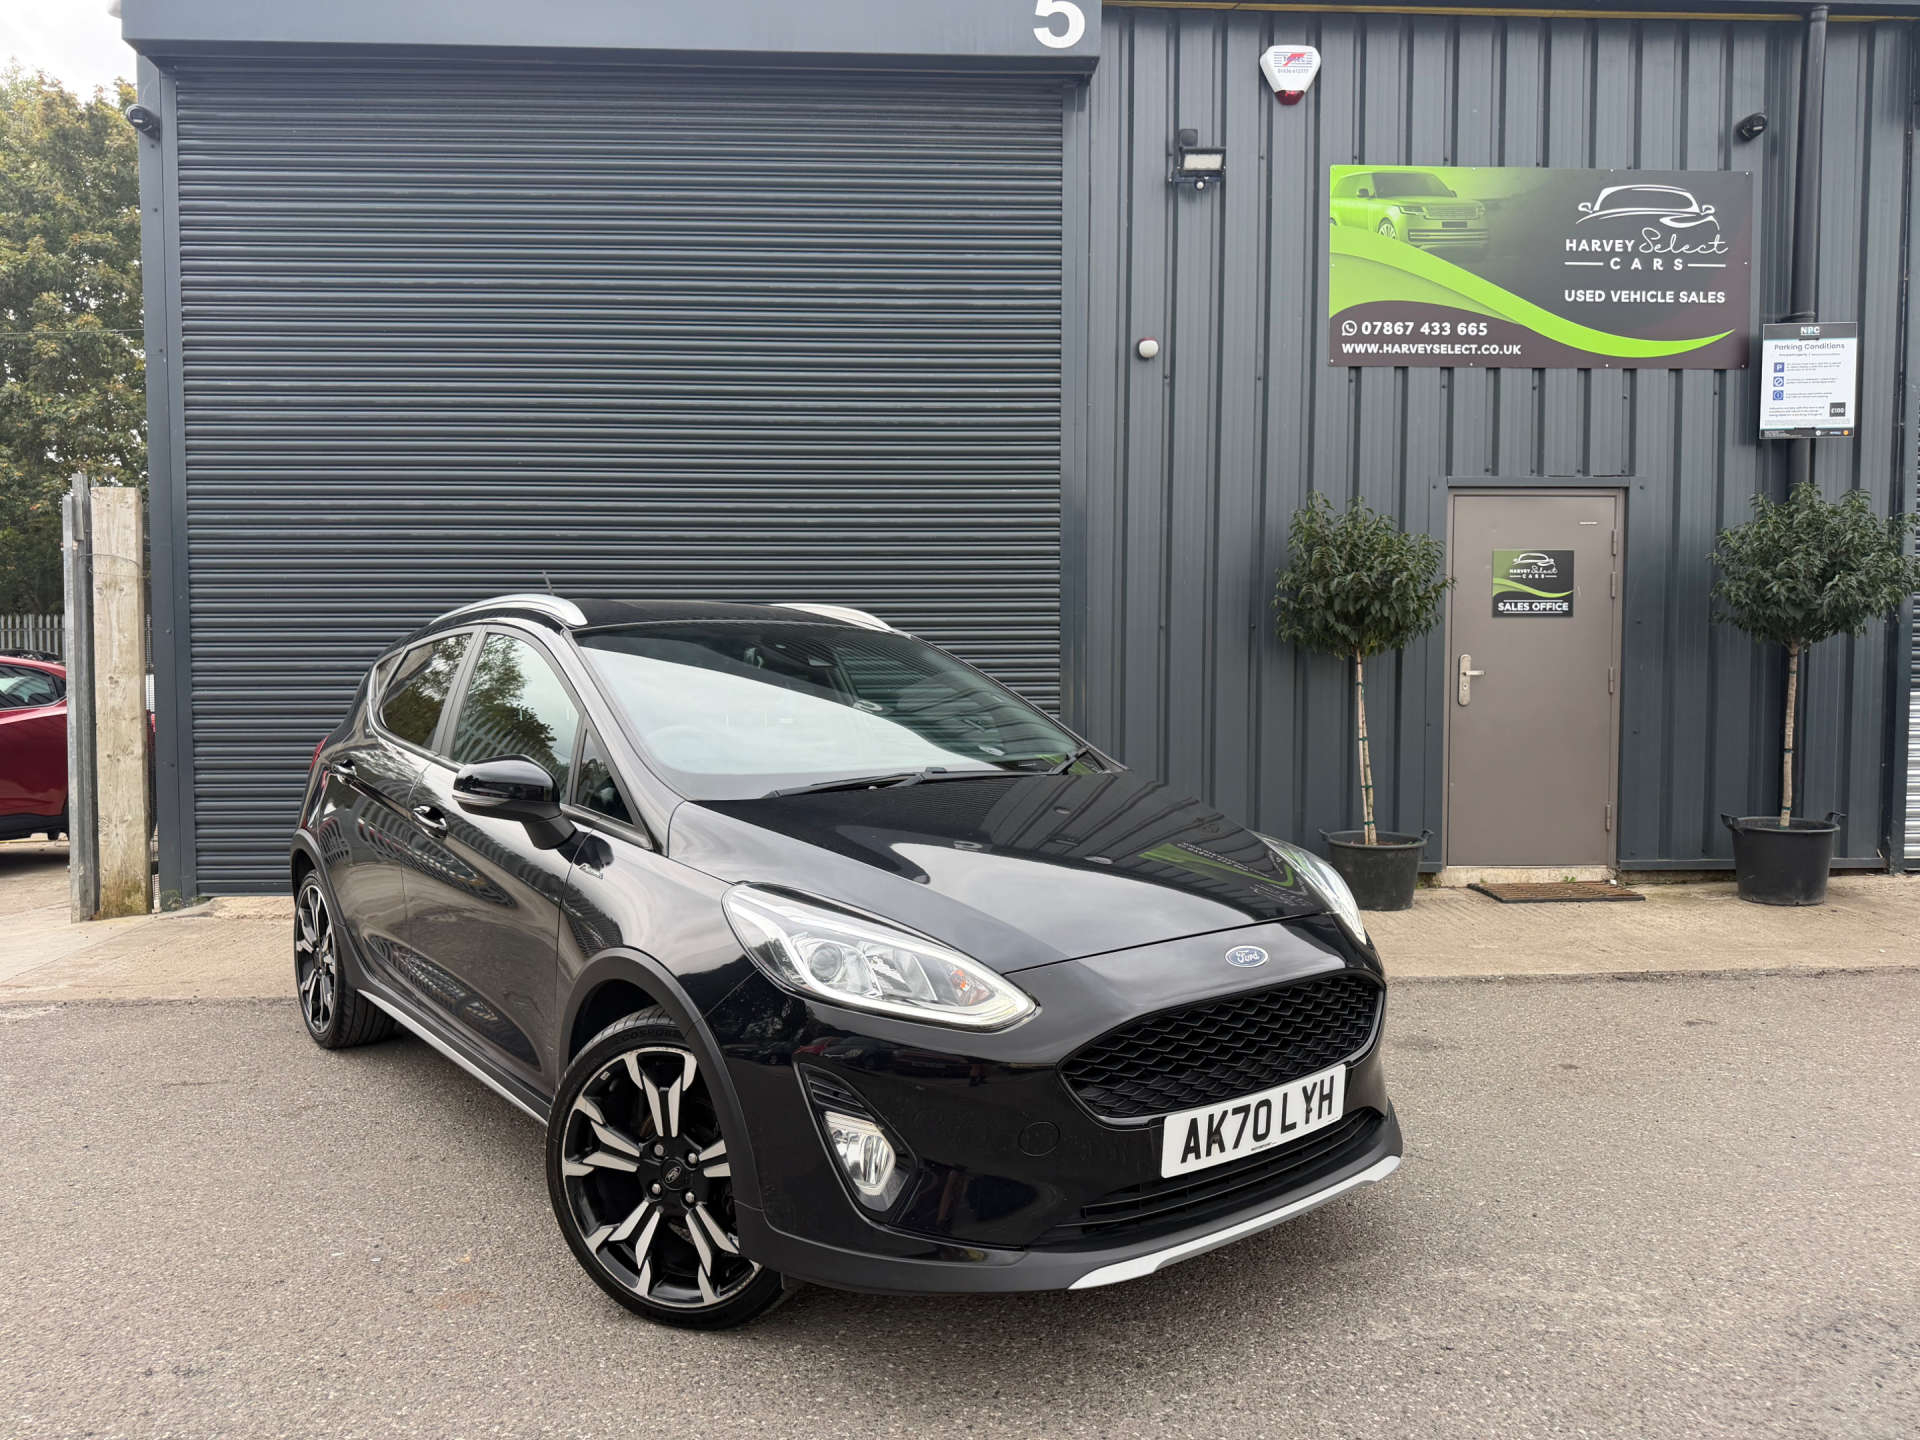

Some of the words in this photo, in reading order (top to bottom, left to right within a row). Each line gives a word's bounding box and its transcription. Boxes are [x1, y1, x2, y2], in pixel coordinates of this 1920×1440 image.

[1033, 0, 1085, 48] 5
[1565, 239, 1635, 252] HARVEY
[1639, 227, 1729, 254] Select
[1609, 257, 1684, 271] CARS
[1564, 289, 1606, 302] USED
[1610, 290, 1675, 303] VEHICLE
[1678, 291, 1726, 304] SALES
[1361, 321, 1415, 335] 07867
[1419, 322, 1451, 336] 433
[1457, 322, 1488, 336] 665
[1341, 343, 1522, 355] WWW.HARVEYSELECT.CO.UK
[1774, 343, 1803, 351] Parking
[1804, 342, 1845, 350] Conditions
[1498, 602, 1530, 611] SALES
[1532, 602, 1569, 611] OFFICE
[1235, 950, 1260, 963] Ford
[1181, 1098, 1272, 1164] AK70
[1280, 1075, 1335, 1134] LYH
